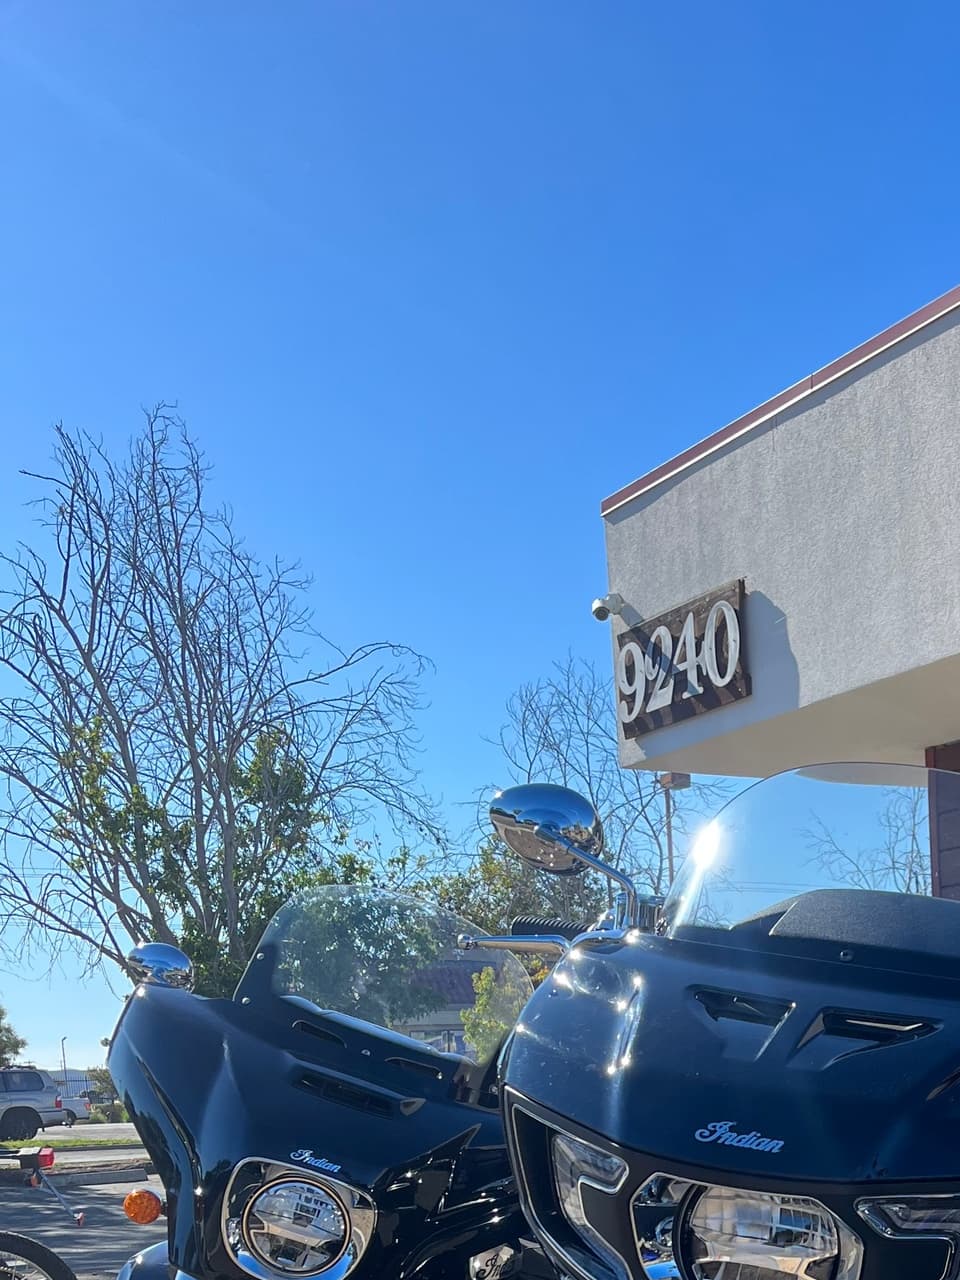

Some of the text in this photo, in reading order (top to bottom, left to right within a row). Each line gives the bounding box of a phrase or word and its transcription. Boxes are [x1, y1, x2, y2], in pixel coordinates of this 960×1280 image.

[618, 600, 740, 723] 9240
[694, 1120, 785, 1153] Indian
[290, 1149, 342, 1173] Indian
